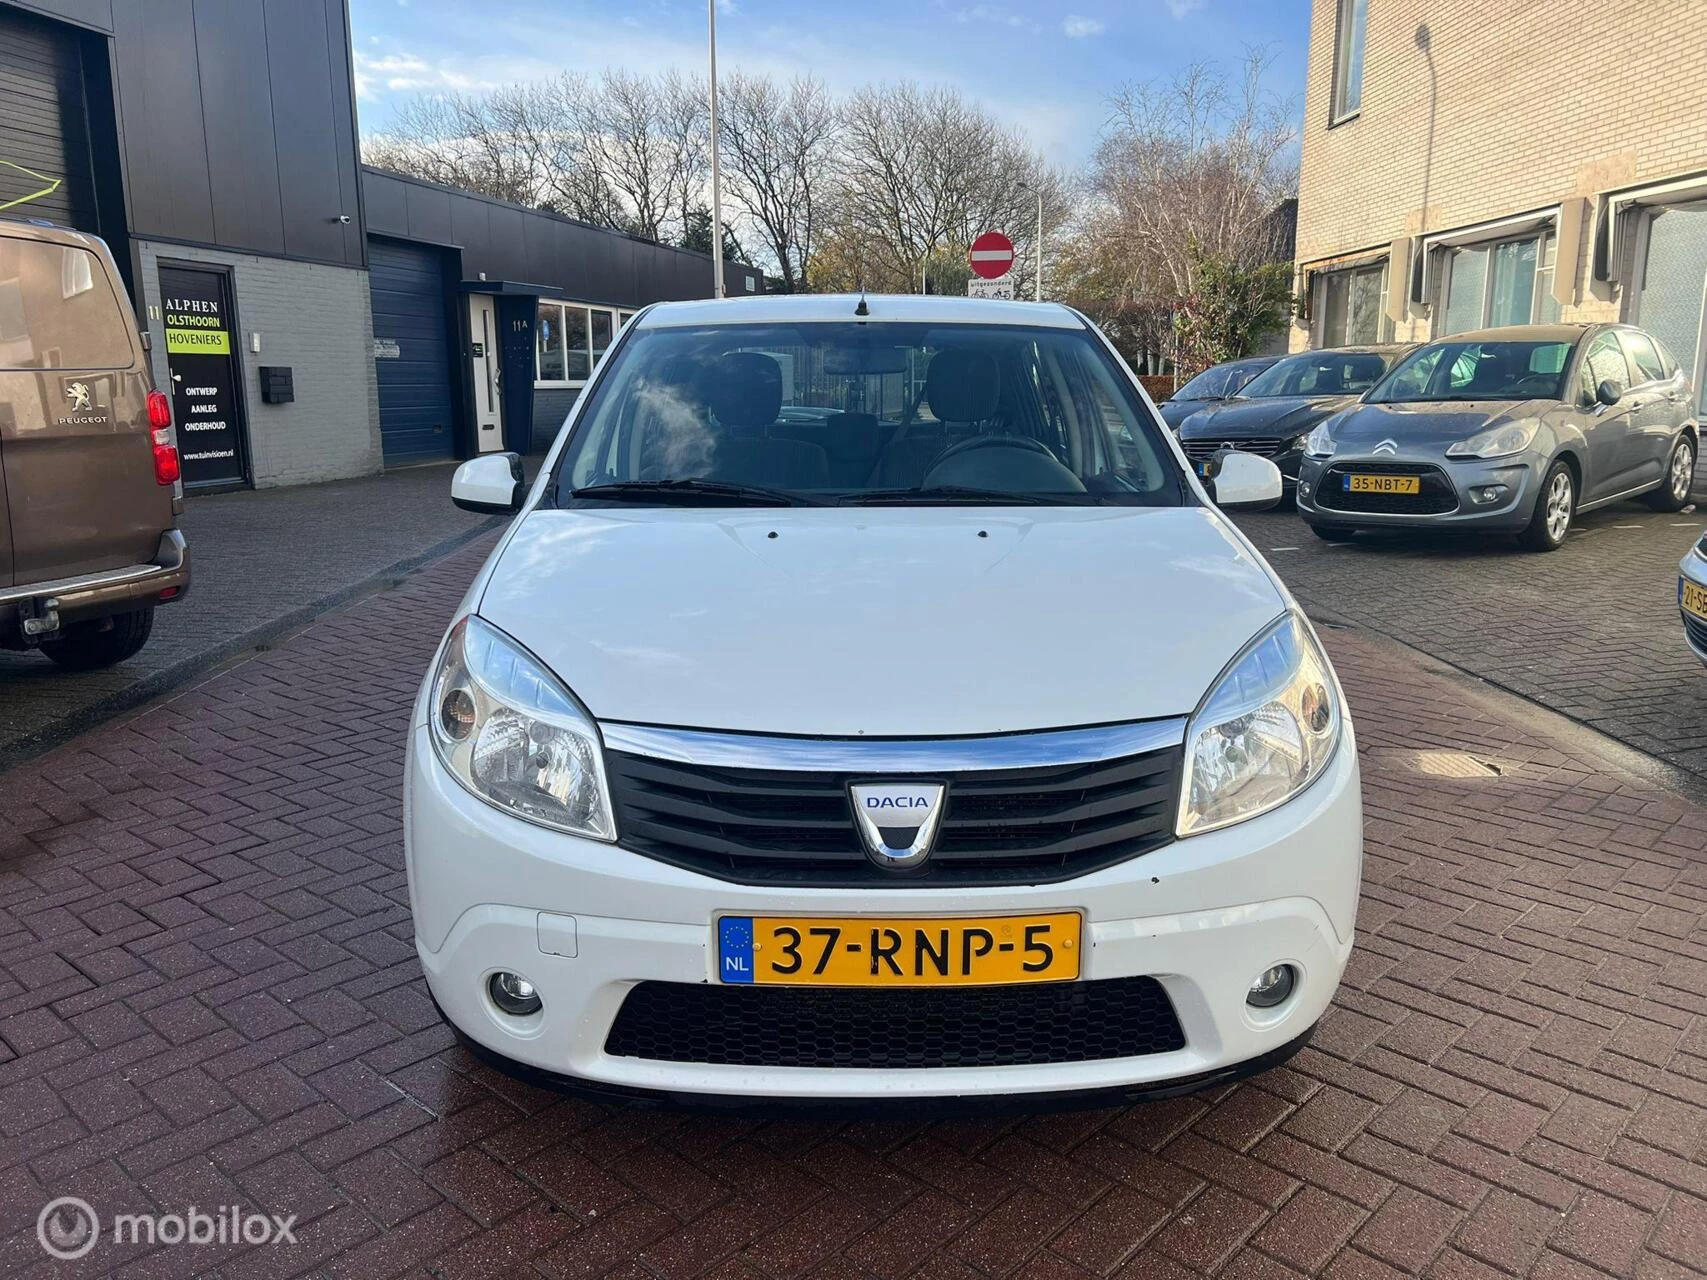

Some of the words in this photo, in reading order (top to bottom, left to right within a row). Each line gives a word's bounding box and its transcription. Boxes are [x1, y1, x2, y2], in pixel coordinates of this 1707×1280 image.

[165, 298, 218, 313] ALPHEN
[149, 305, 160, 320] 11
[167, 314, 220, 328] OLSTHOORN
[169, 333, 222, 346] HOVENIERS
[185, 387, 218, 396] ONTWERP
[191, 404, 217, 413] AANLEG
[58, 416, 108, 424] PEUGEOT
[184, 421, 226, 431] ONDERHOUD
[1353, 478, 1413, 491] 35-NBT-7
[867, 796, 929, 808] DACIA
[771, 925, 1054, 976] 37-RNP-5
[725, 957, 749, 971] NL
